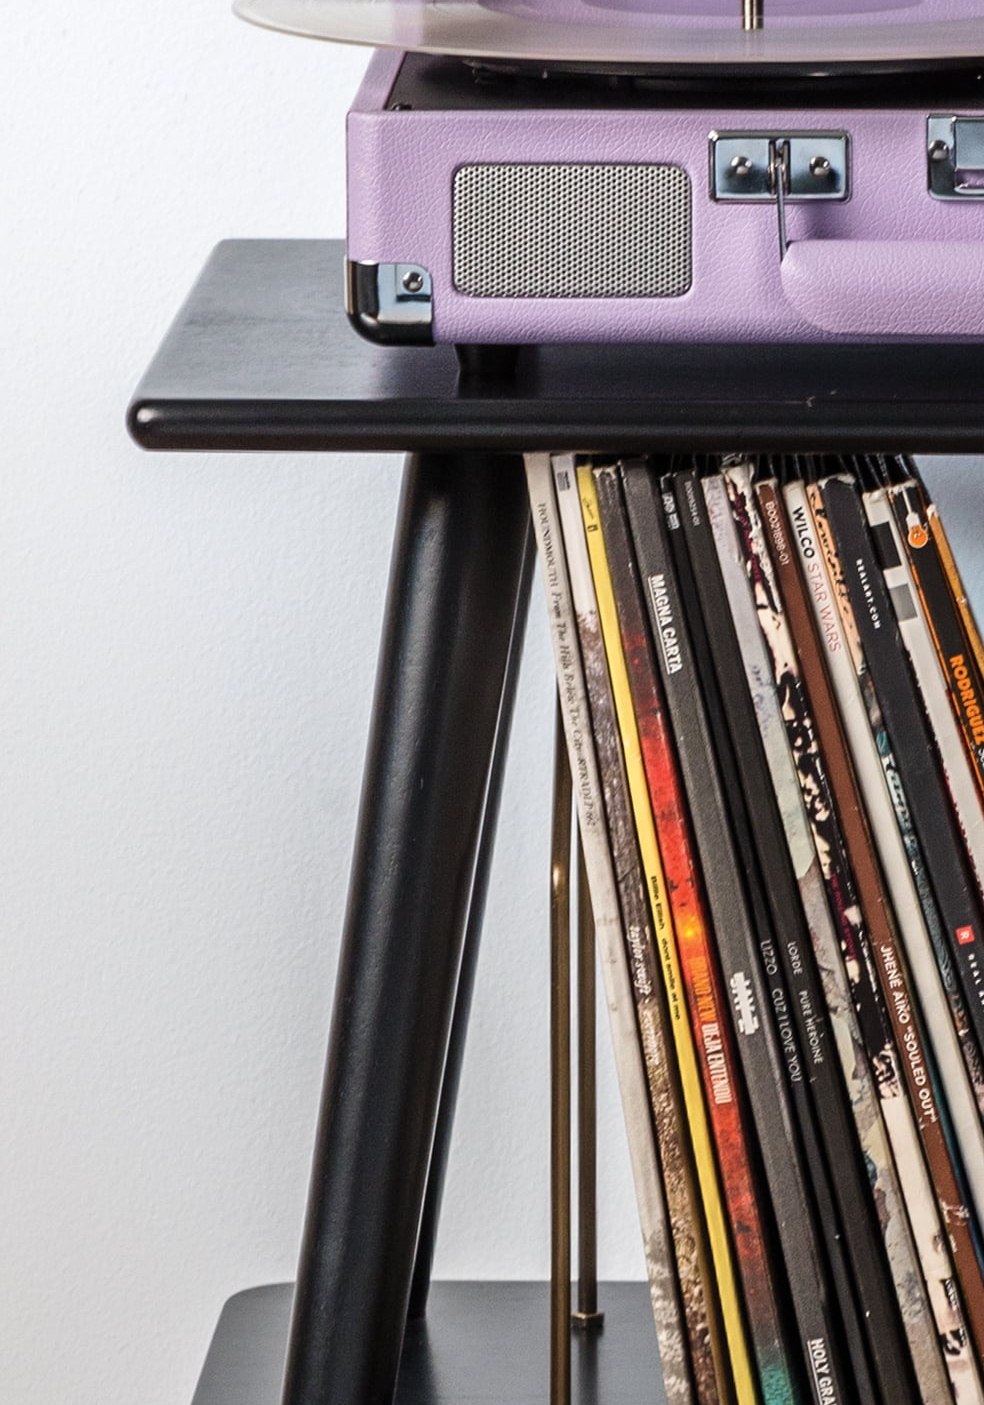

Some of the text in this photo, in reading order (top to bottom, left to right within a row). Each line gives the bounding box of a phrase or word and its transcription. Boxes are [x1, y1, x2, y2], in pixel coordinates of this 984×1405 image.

[792, 506, 843, 653] WILCO STAR WARS
[856, 558, 881, 629] REALART.COM
[648, 574, 683, 674] MAGNA CARTA
[556, 622, 567, 642] The
[569, 705, 580, 727] The
[760, 939, 778, 975] LIZZO
[787, 941, 803, 975] LORDE
[960, 930, 970, 940] R
[968, 953, 981, 985] REAL
[686, 955, 717, 1022] BRAND NEW
[771, 988, 787, 1013] CUZ
[779, 1021, 796, 1053] LOVE
[788, 1054, 802, 1082] YOU
[799, 990, 823, 1064] PURE HEROINE
[701, 1022, 732, 1104] DEJA ENTENDU
[807, 1338, 830, 1374] HOLY
